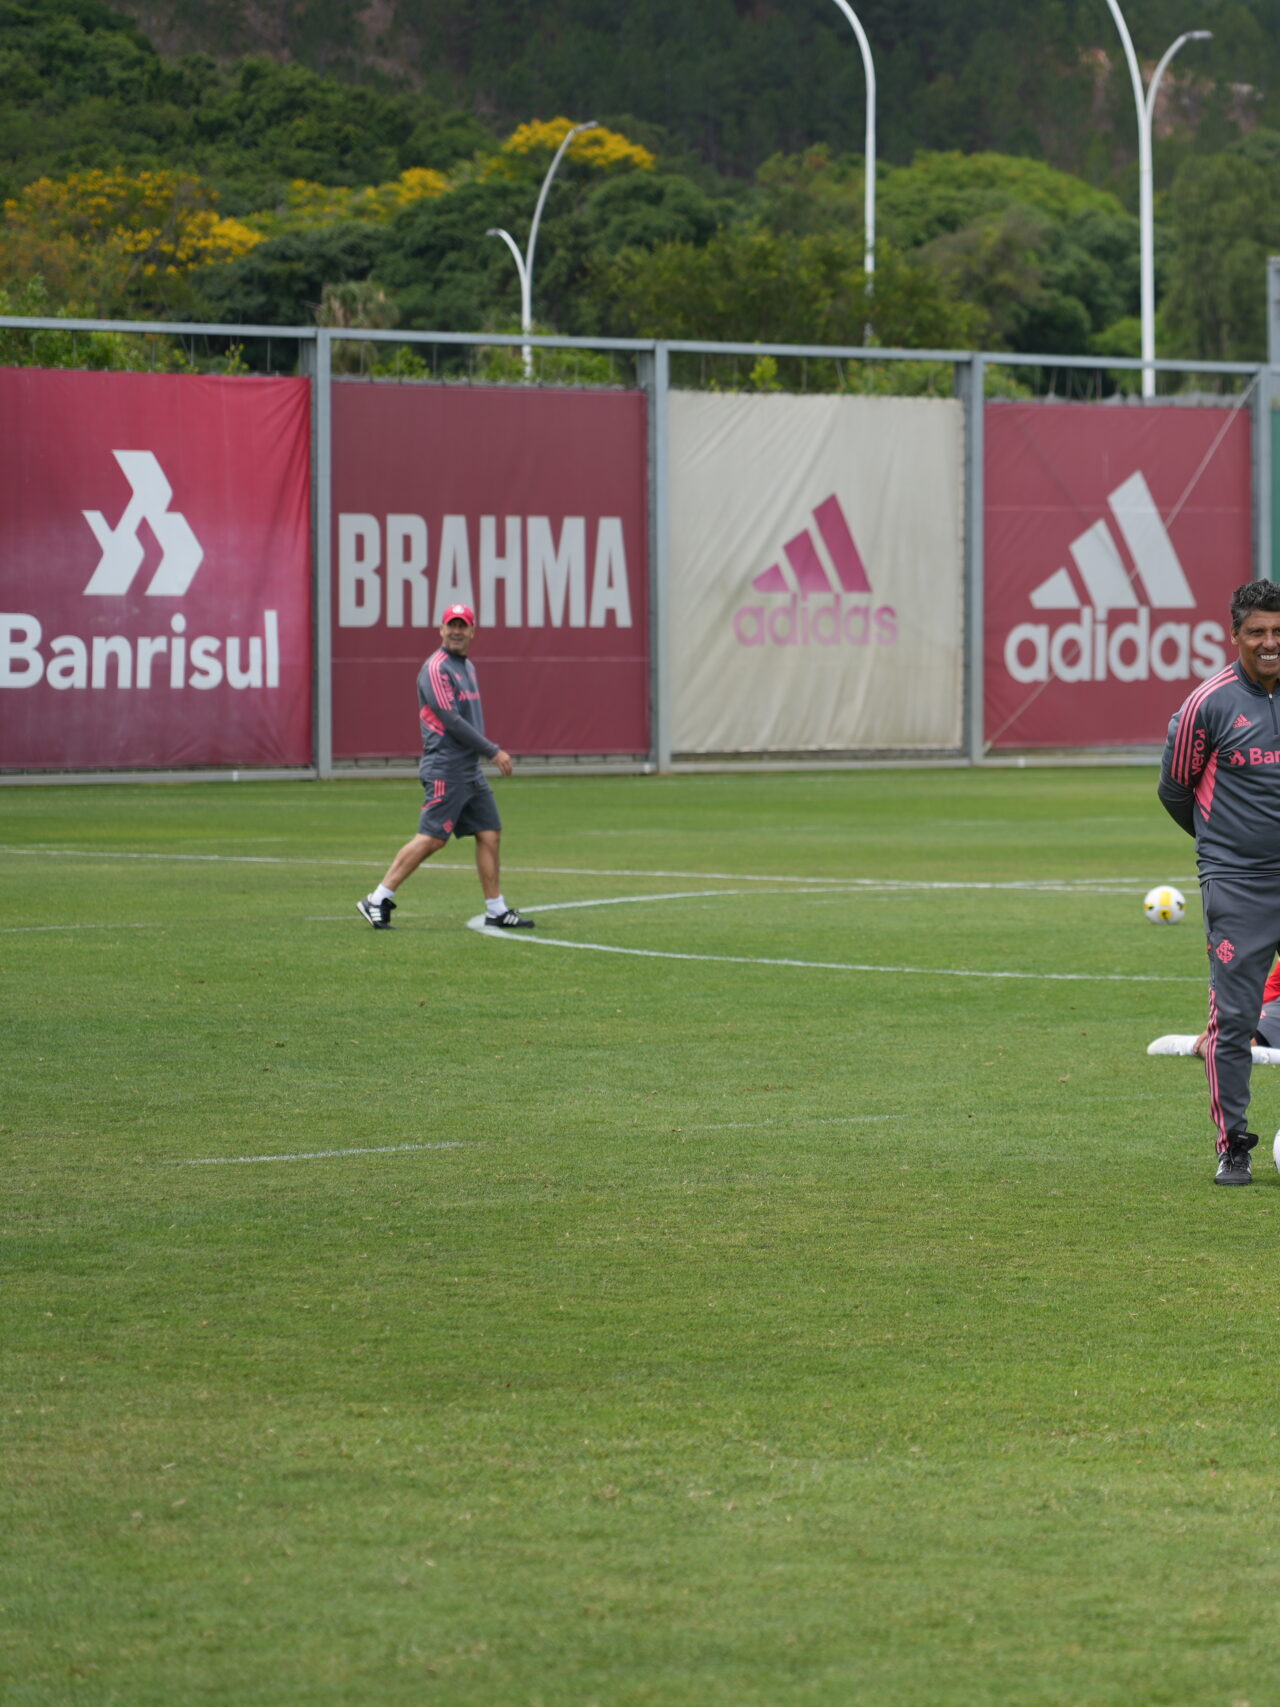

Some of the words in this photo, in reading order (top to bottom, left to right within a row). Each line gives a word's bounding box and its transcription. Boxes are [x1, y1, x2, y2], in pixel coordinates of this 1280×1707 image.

[338, 513, 632, 628] BRAHMA
[0, 609, 280, 690] Banrisul
[733, 595, 898, 647] adidas
[1004, 606, 1226, 683] adidas
